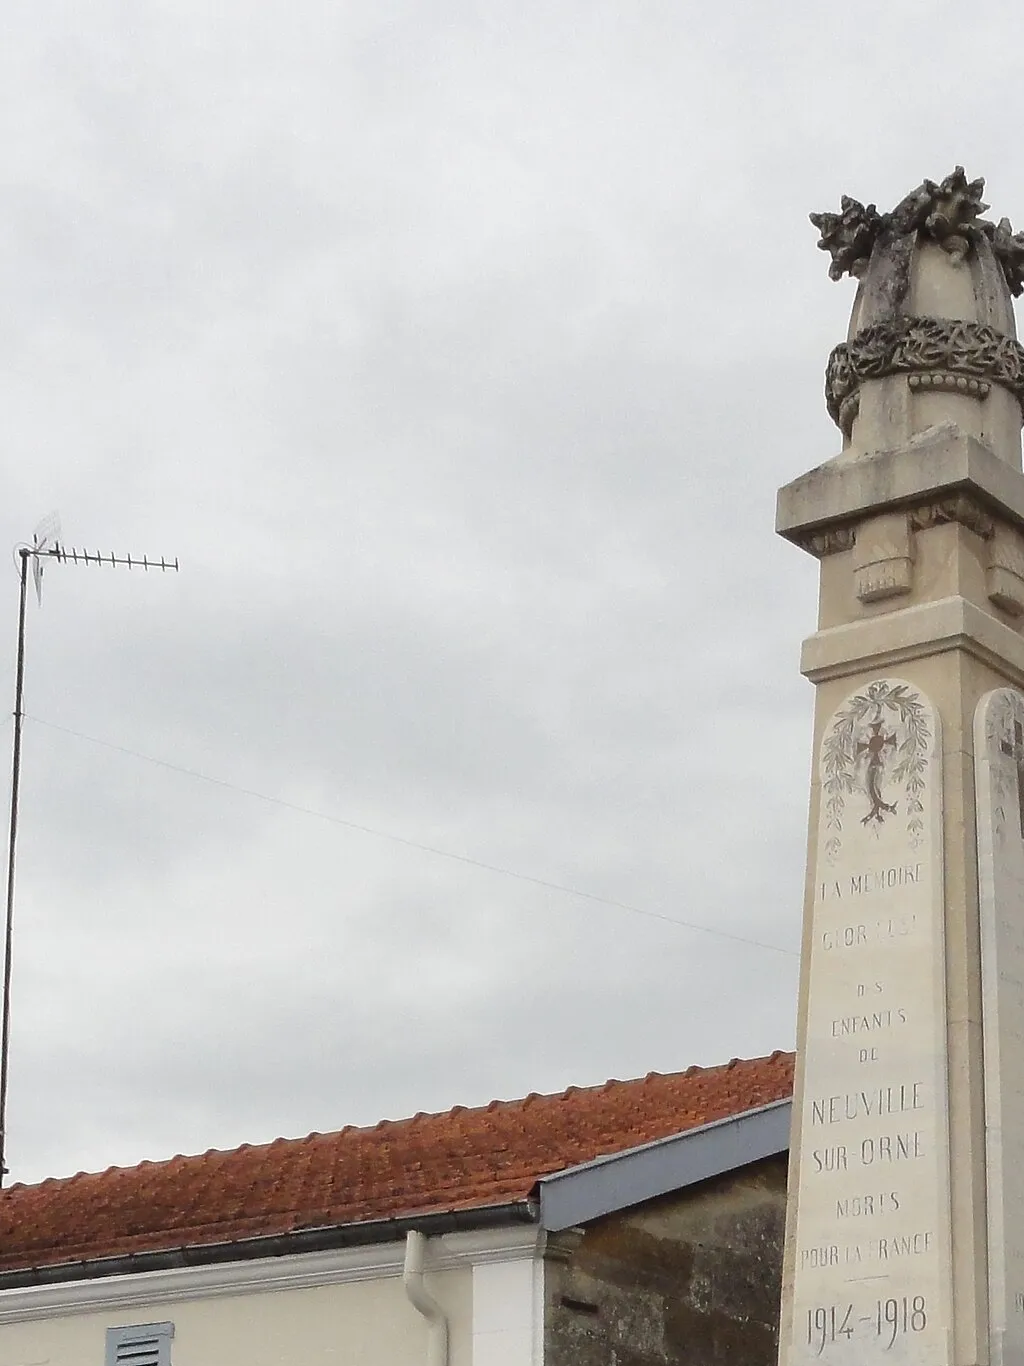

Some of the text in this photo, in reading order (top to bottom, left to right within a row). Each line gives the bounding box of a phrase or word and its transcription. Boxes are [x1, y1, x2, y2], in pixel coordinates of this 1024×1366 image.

[857, 980, 885, 999] DS
[831, 1007, 908, 1037] ENFANTS
[812, 1081, 925, 1126] NEUVILLE
[812, 1130, 926, 1173] SUR-ORNE
[836, 1190, 901, 1220] MORTS
[801, 1245, 839, 1270] POUR
[867, 1231, 933, 1261] RANCE
[807, 1295, 927, 1357] 1914-1918
